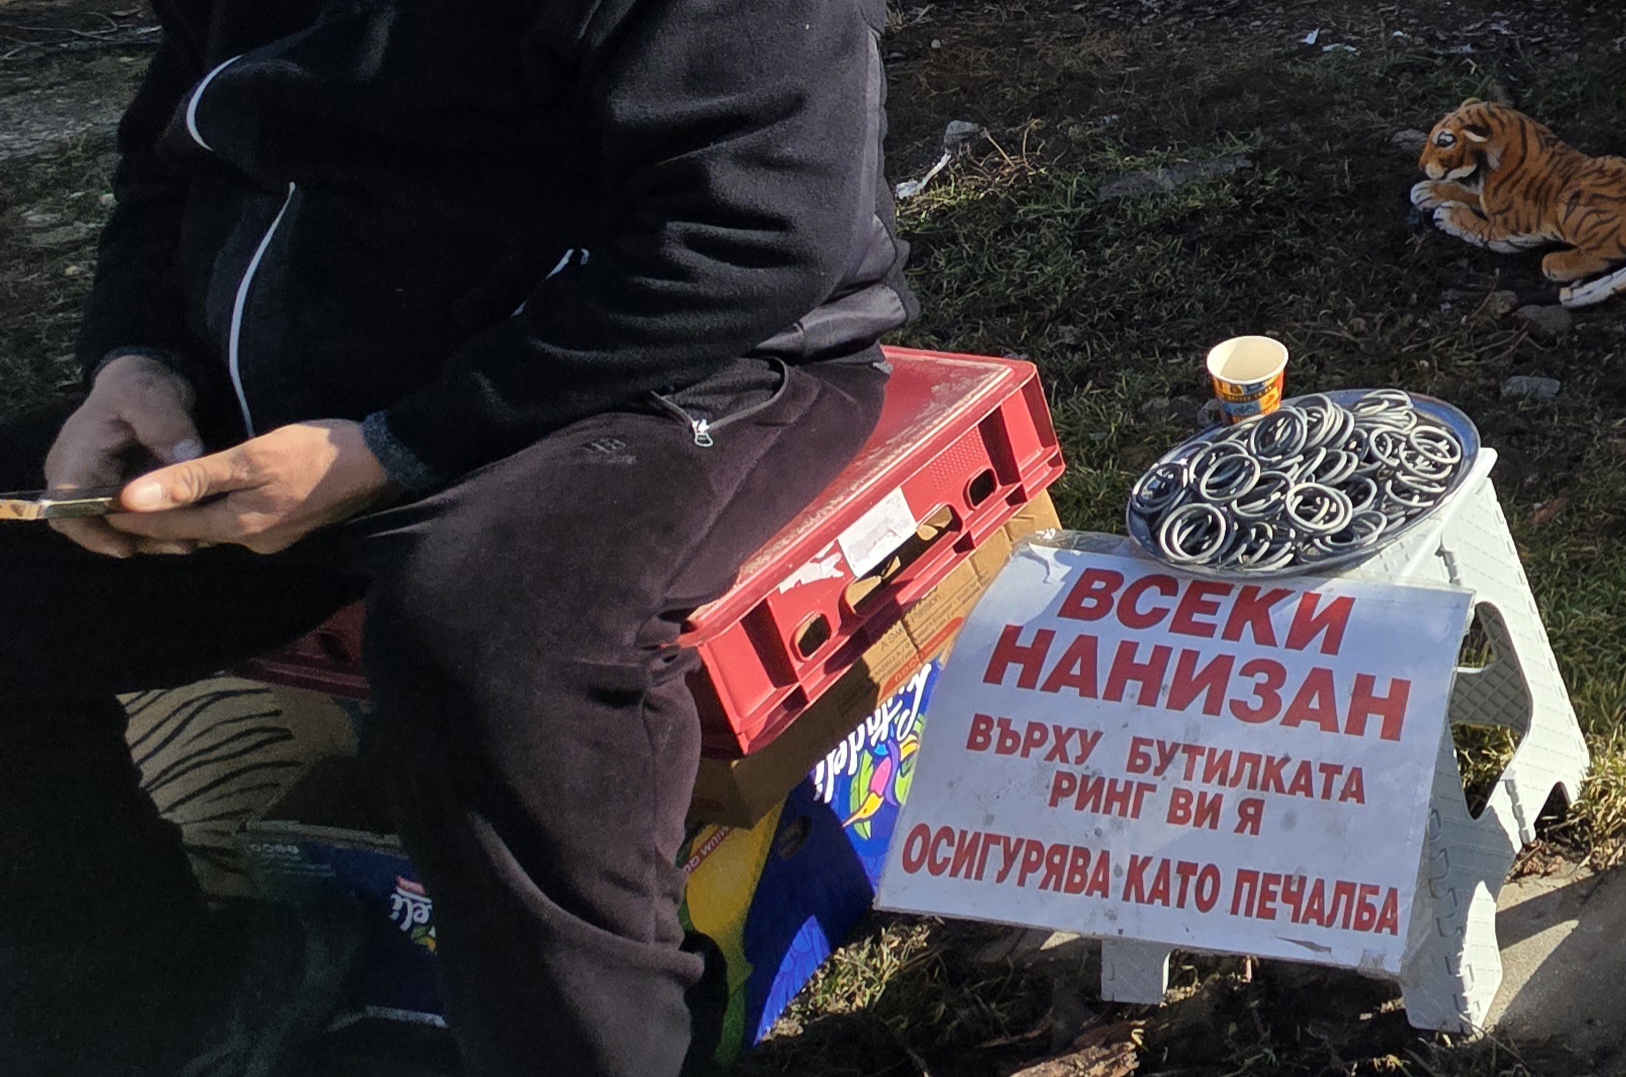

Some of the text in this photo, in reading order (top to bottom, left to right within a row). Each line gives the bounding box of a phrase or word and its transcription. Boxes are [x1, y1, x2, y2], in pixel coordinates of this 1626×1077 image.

[1057, 568, 1357, 656] ВСЕКИ
[983, 624, 1412, 742] НАНИЗАН
[966, 713, 1367, 805] ВЪРХУ БУТИЛКАТА
[1049, 772, 1266, 836] РИНГ ВИ Я
[901, 823, 1400, 937] ОСИГУРЯВА КАТО ПЕЧАЛБА
